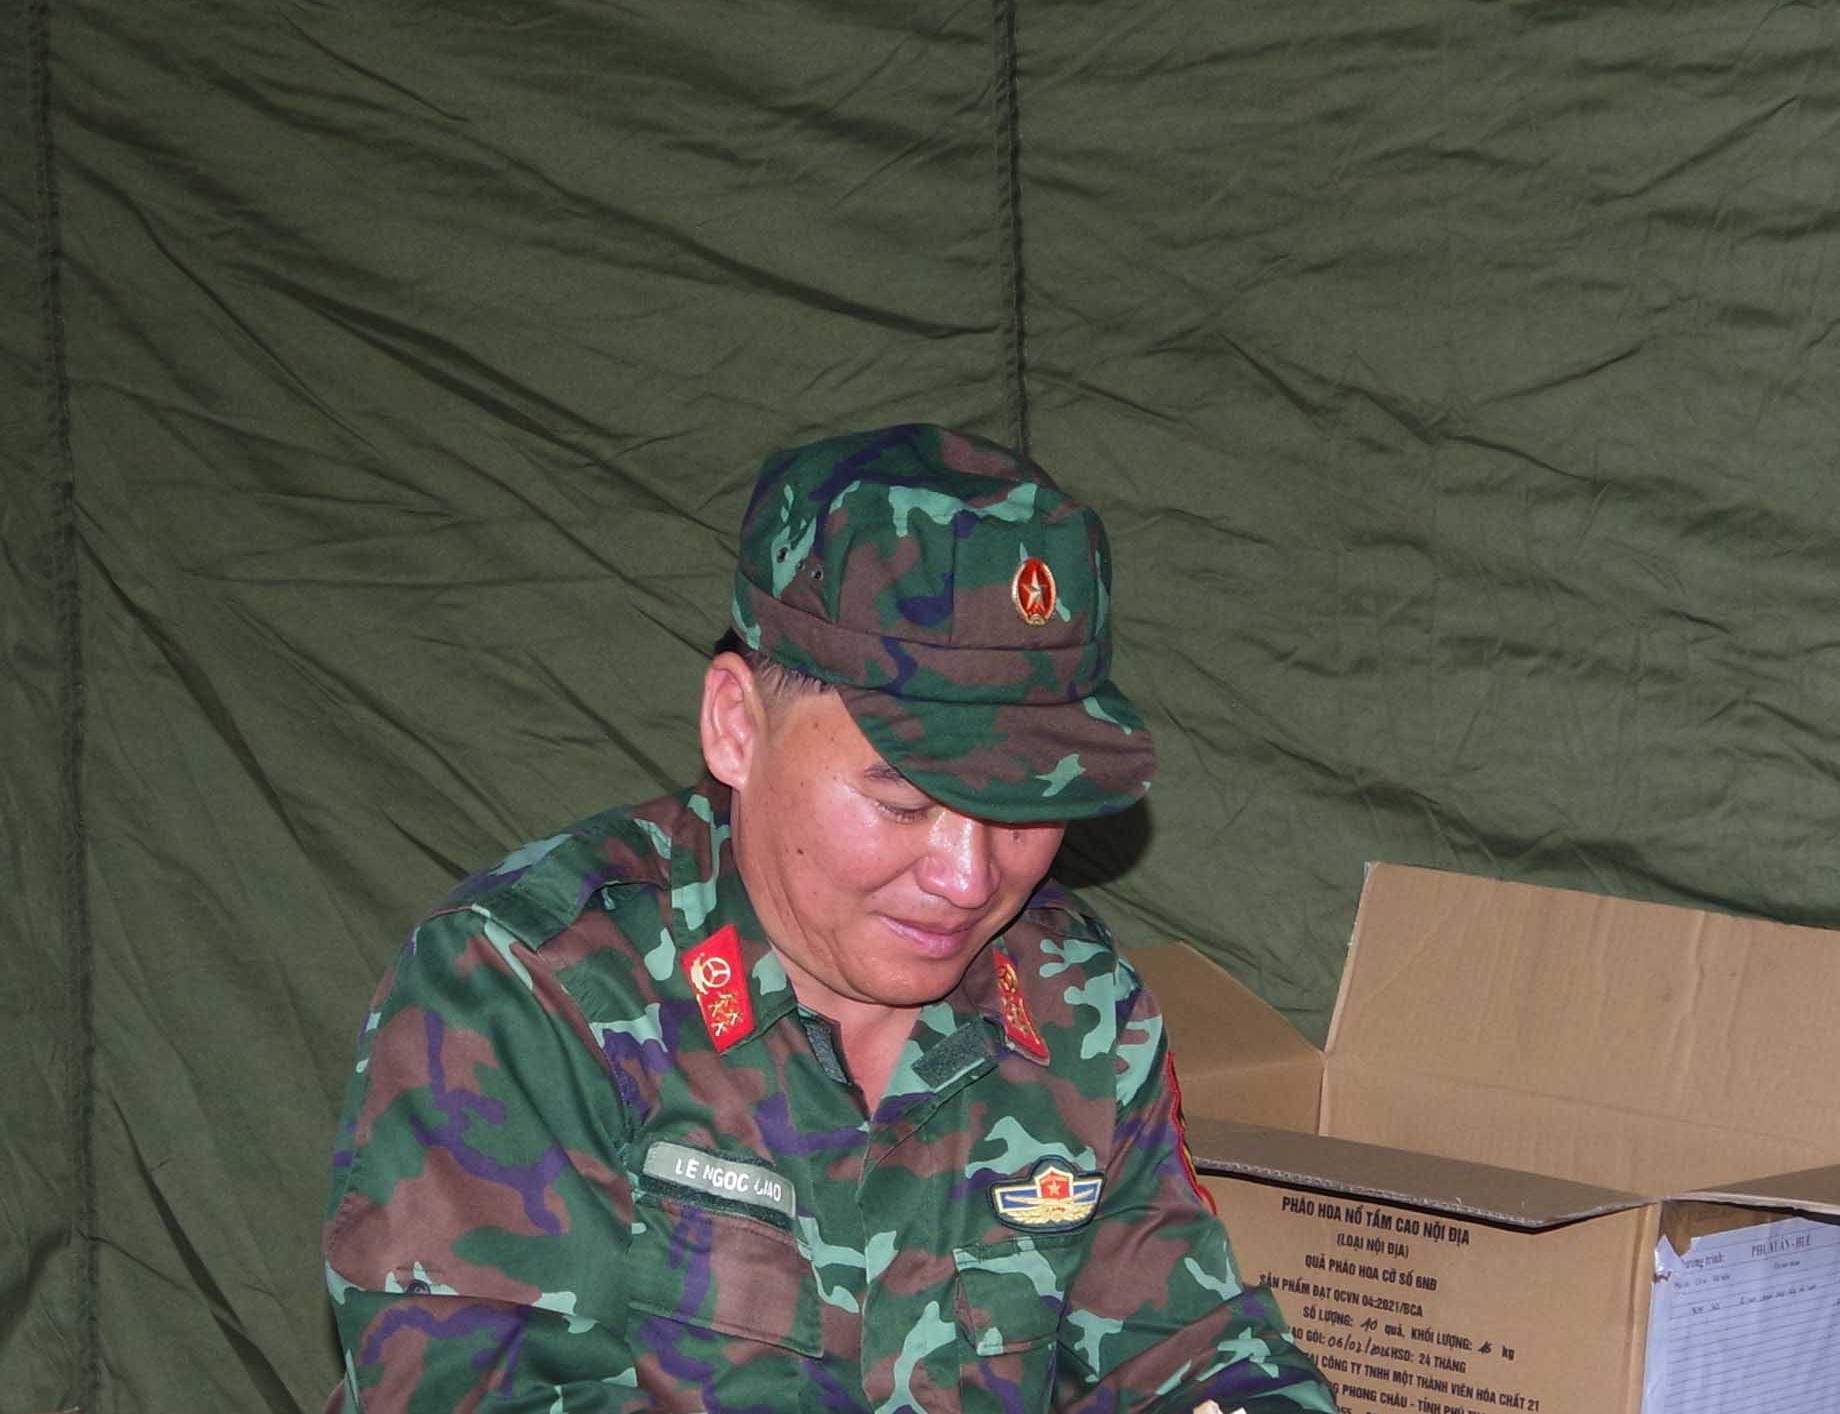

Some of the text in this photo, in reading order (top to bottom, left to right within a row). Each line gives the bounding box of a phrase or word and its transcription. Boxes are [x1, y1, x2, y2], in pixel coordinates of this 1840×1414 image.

[1282, 1195, 1314, 1216] PHÁO
[1318, 1202, 1342, 1222] HOA
[1395, 1217, 1420, 1235] CAO
[1423, 1221, 1446, 1243] NỘI
[1448, 1226, 1471, 1248] ĐỊA
[1366, 1237, 1385, 1255] NỘI
[1259, 1272, 1280, 1289] SẢN
[1312, 1285, 1331, 1300] ĐẠT
[1334, 1289, 1360, 1305] QCVN
[1305, 1253, 1326, 1270] QUẢ
[1328, 1258, 1356, 1276] PHÁO
[1358, 1265, 1379, 1280] HOA
[1399, 1269, 1414, 1287] SỐ
[1303, 1304, 1316, 1319] SỐ
[1411, 1325, 1434, 1344] KHỐI
[1288, 1325, 1303, 1340] AO
[1419, 1352, 1431, 1367] 24
[1433, 1355, 1467, 1373] THÁNG
[1321, 1354, 1348, 1372] CÔNG
[1350, 1362, 1362, 1375] TY
[1364, 1364, 1390, 1380] TNHH
[1392, 1370, 1414, 1387] MỘT
[1416, 1374, 1448, 1393] THÀNH
[1451, 1382, 1474, 1399] VIÊN
[1527, 1398, 1540, 1412] 21
[1342, 1384, 1377, 1402] PHONG
[1379, 1392, 1408, 1408] CHÂU
[1417, 1396, 1440, 1414] TỈNH
